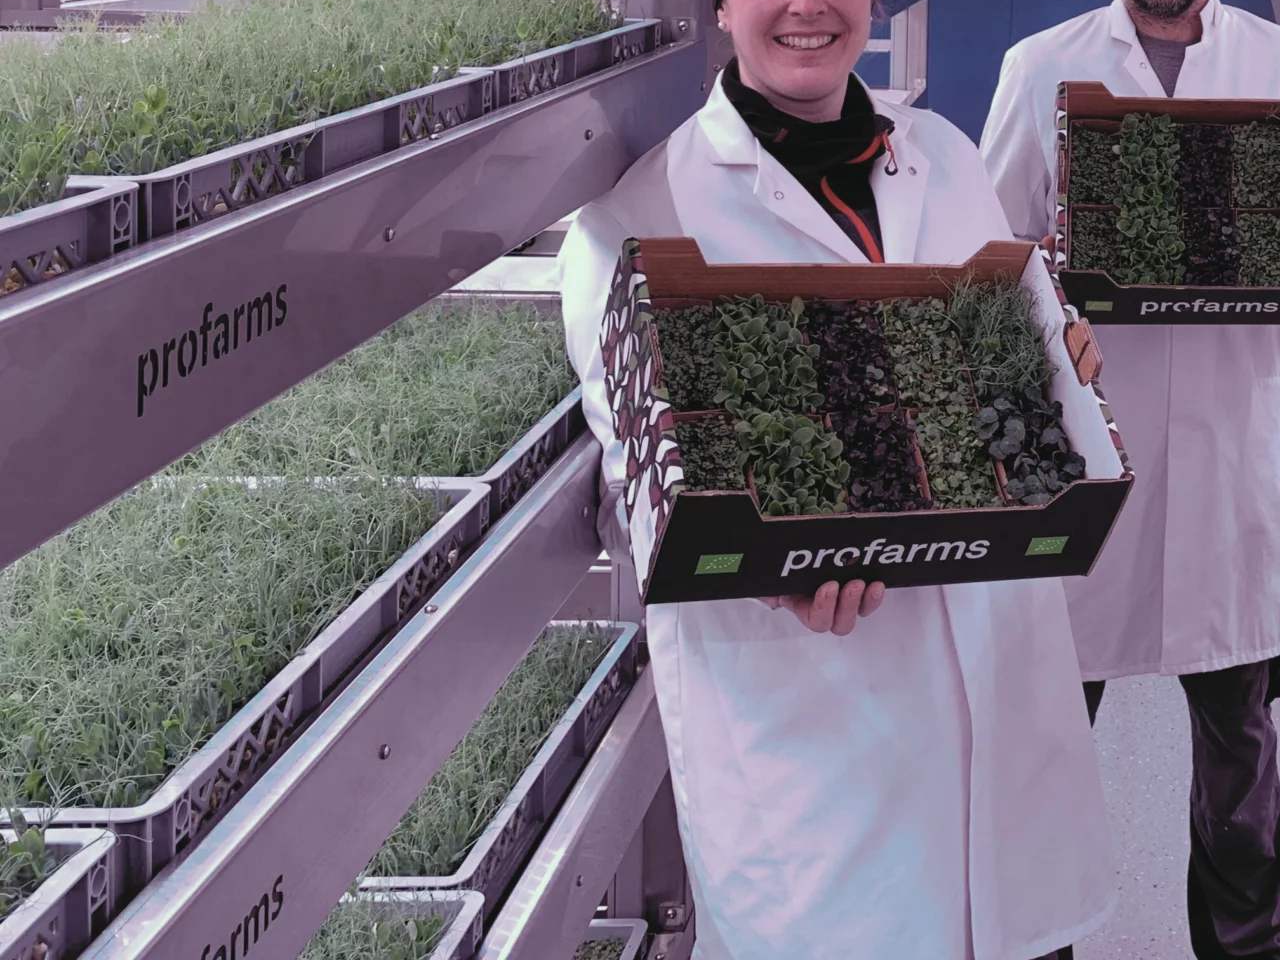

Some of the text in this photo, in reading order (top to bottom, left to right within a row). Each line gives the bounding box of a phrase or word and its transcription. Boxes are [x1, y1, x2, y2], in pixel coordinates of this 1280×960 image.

[1140, 298, 1279, 315] profarms
[137, 284, 287, 418] profarms
[780, 538, 990, 577] profarms
